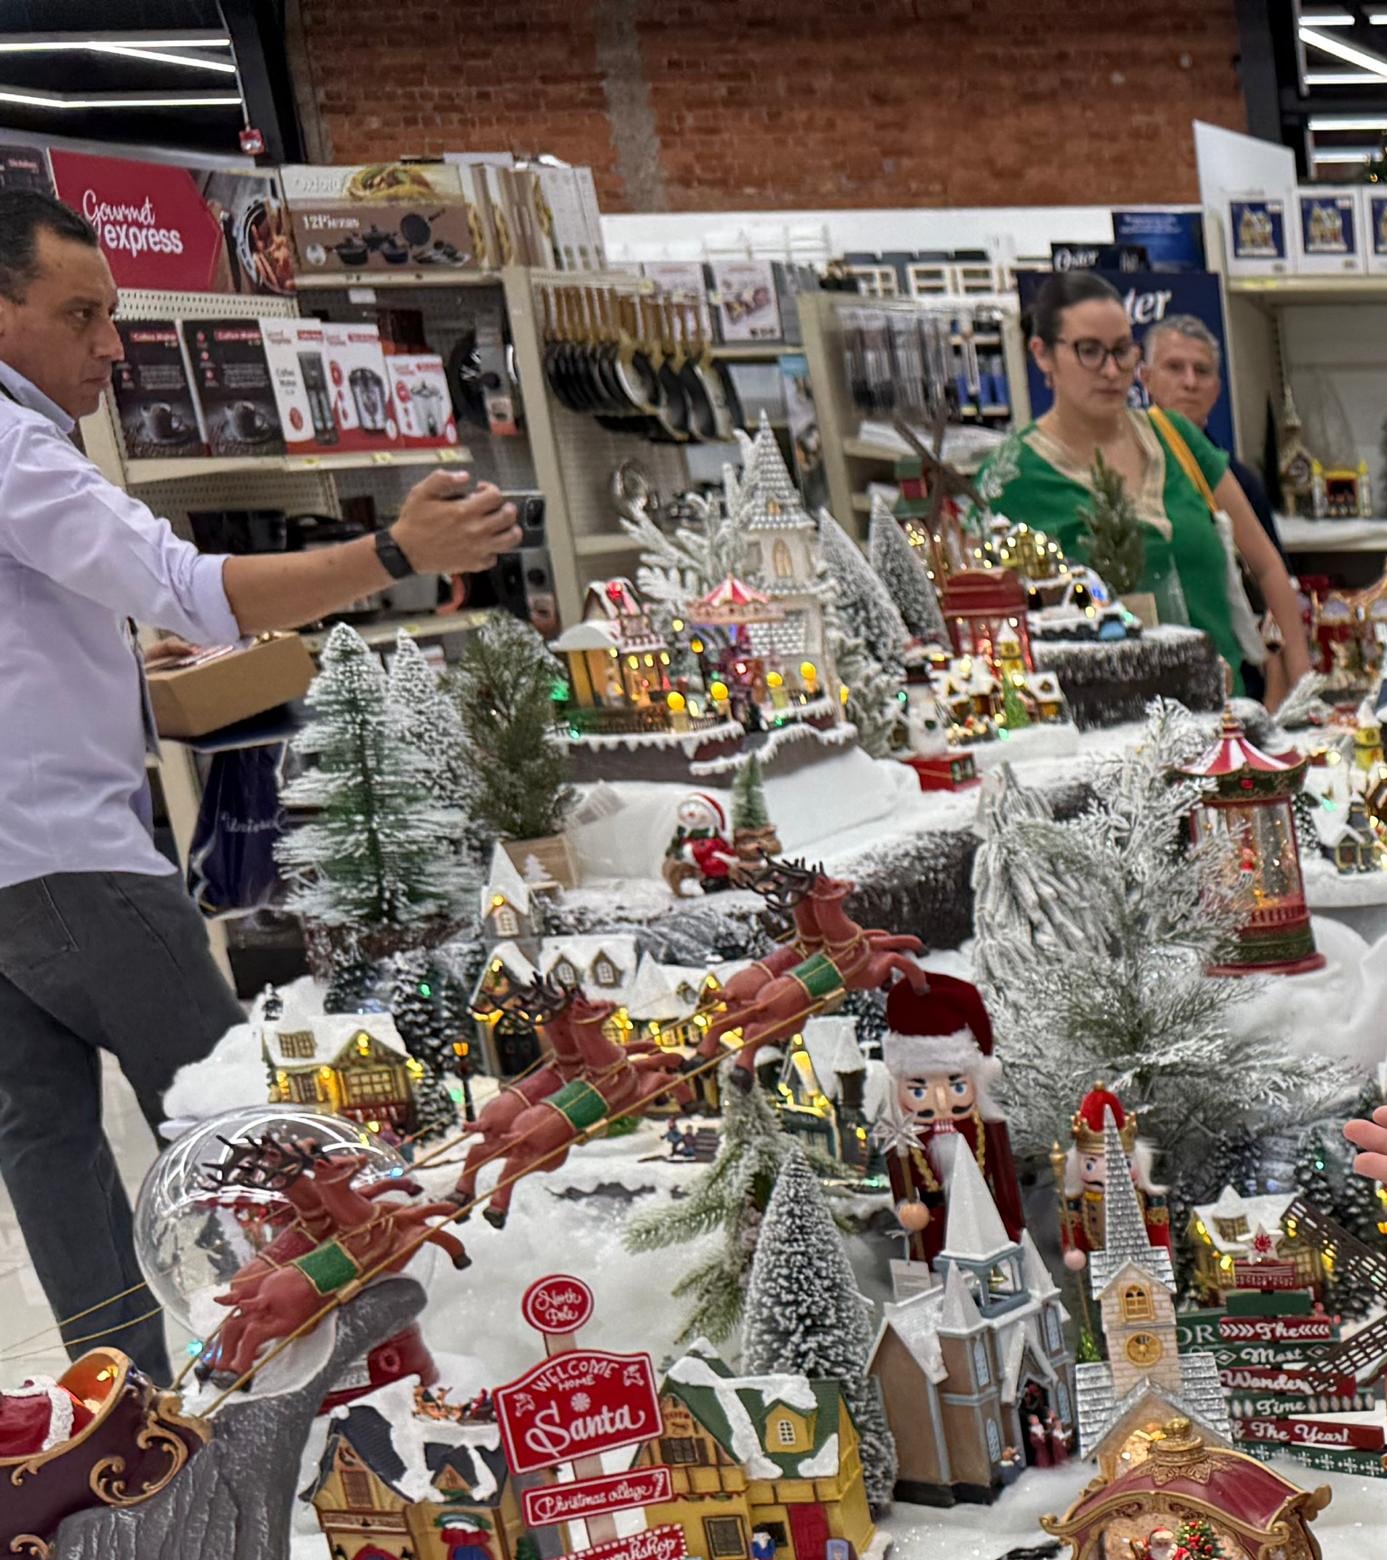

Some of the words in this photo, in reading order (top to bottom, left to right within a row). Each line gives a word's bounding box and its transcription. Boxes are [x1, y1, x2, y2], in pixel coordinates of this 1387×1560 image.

[83, 188, 156, 234] Gourmet
[104, 223, 184, 257] express
[535, 1287, 581, 1311] North
[545, 1306, 578, 1326] Pole
[1256, 1322, 1301, 1340] The
[1241, 1347, 1304, 1364] Most
[532, 1359, 619, 1392] WELCOME
[558, 1374, 596, 1392] HOME
[1256, 1399, 1306, 1415] Time
[525, 1399, 646, 1458] Santa
[1251, 1422, 1290, 1441] The
[1294, 1423, 1349, 1443] Year!
[535, 1491, 607, 1520] Christmas
